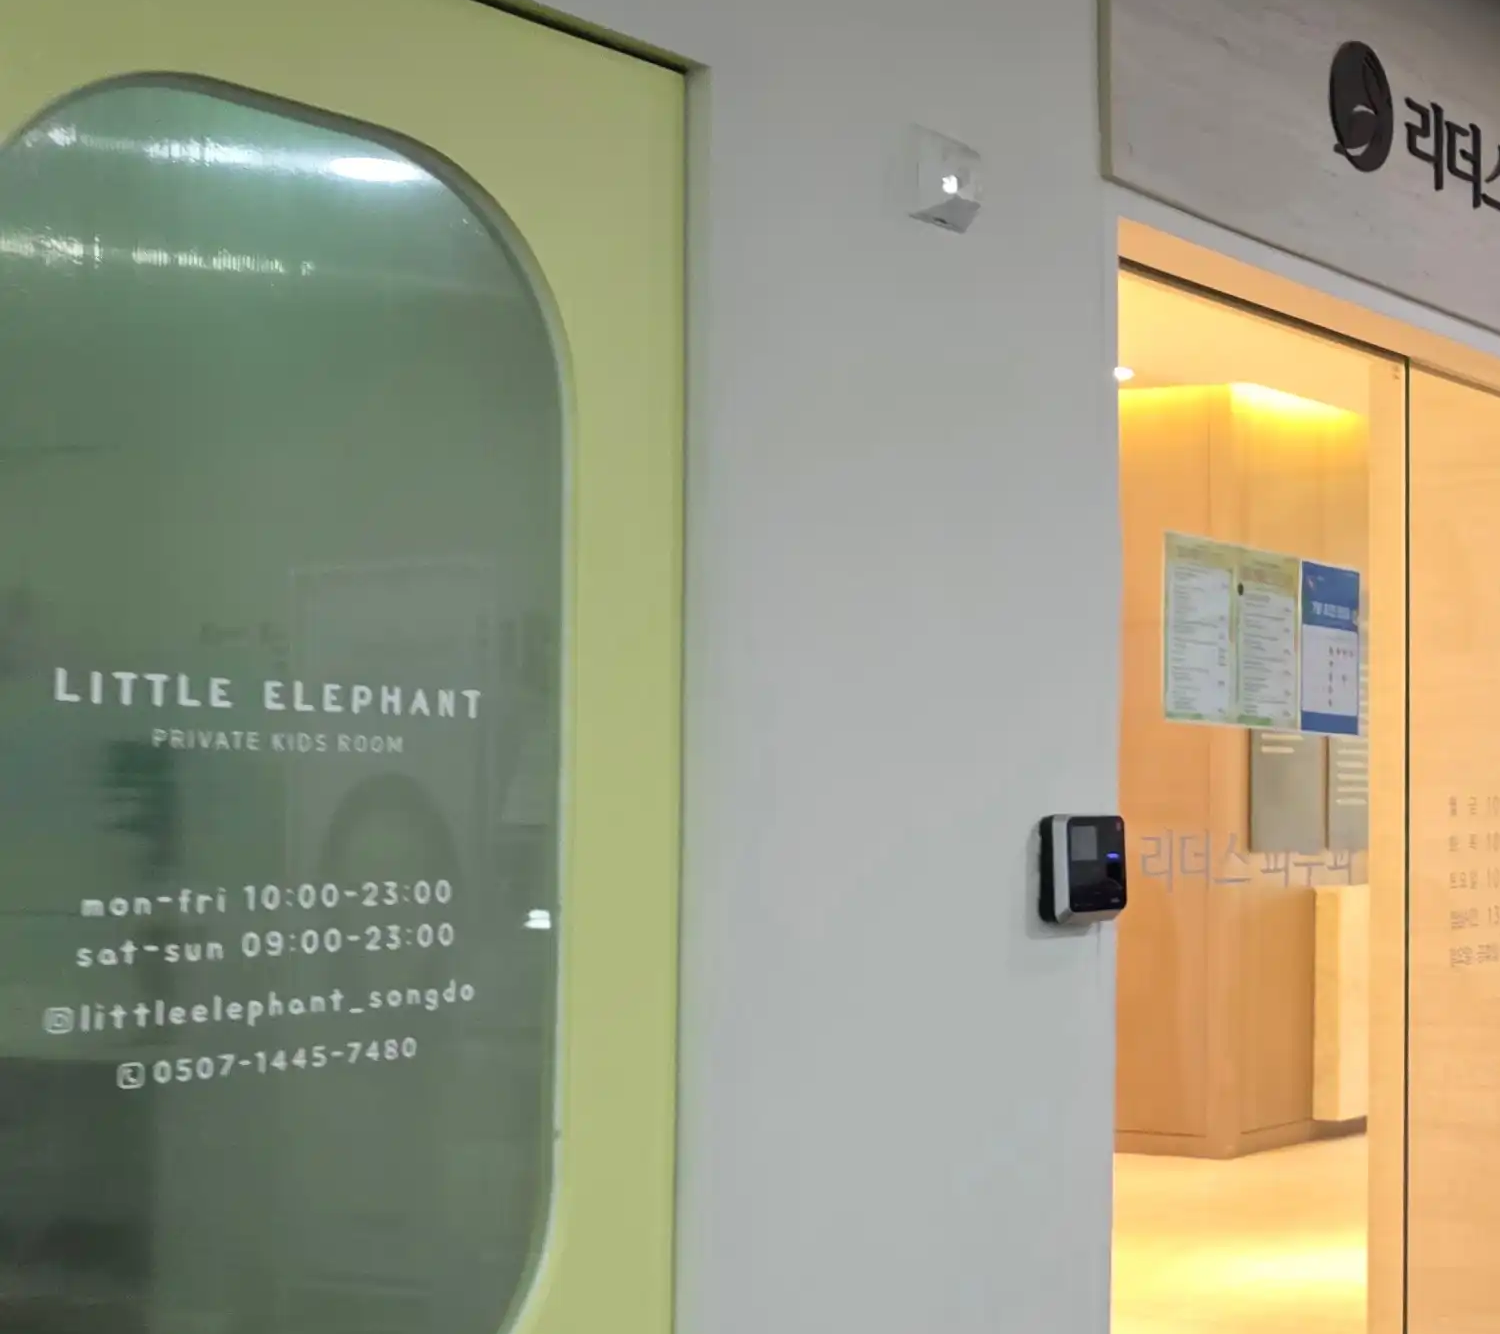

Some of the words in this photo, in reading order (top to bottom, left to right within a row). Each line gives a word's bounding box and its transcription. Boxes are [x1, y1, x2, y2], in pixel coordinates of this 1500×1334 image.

[54, 667, 233, 709] LITTLE
[264, 680, 482, 719] ELEPHANT
[152, 728, 260, 752] PRIVATE
[272, 731, 327, 753] KIDS
[337, 733, 404, 755] ROOM
[80, 886, 228, 918] mon-fri
[243, 879, 453, 911] 10:00-23:00
[75, 939, 225, 968] sat-sun
[241, 923, 456, 958] 09:00-23:00
[152, 1037, 418, 1084] 0507-1445-7480
